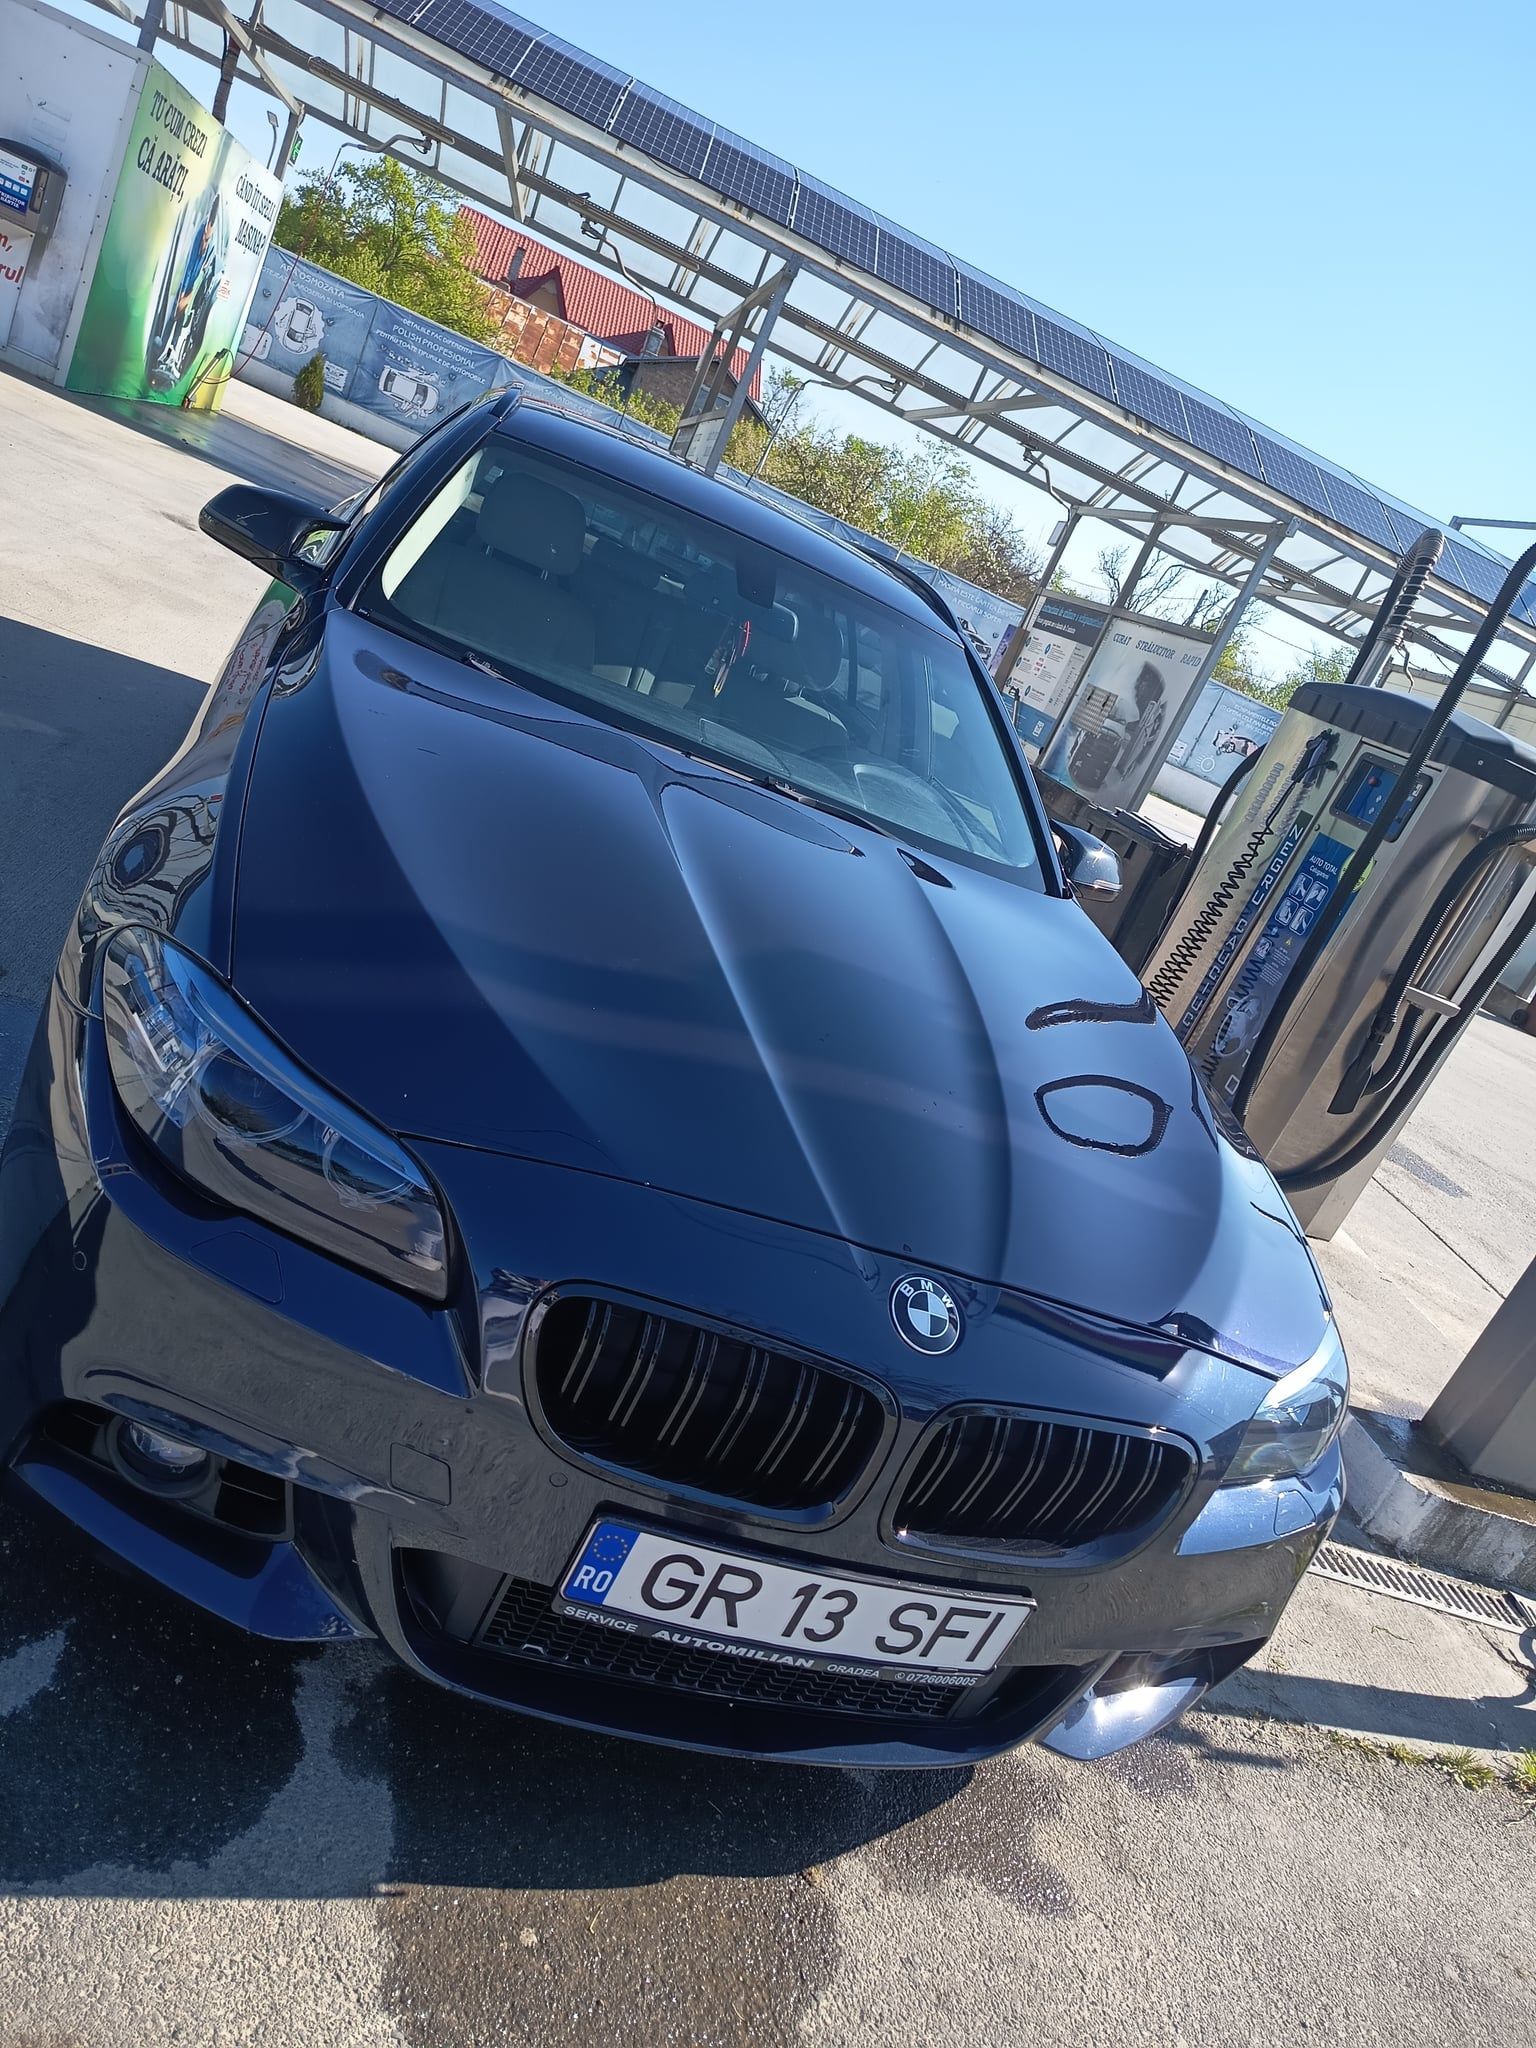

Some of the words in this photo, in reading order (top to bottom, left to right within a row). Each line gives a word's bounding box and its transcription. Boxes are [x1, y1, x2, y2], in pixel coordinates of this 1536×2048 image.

[150, 89, 168, 122] TU
[164, 104, 186, 140] CUM
[183, 120, 208, 158] CREZI
[137, 135, 158, 174] CĂ
[299, 271, 345, 299] OSMOZATA
[375, 329, 399, 344] PENTRU
[399, 340, 418, 353] TOATE
[442, 360, 450, 368] DE
[449, 364, 486, 385] AUTOMOBILE
[392, 324, 422, 343] POLISH
[421, 339, 475, 369] PROFESIONAL
[1180, 653, 1202, 668] RAPID
[1252, 824, 1304, 906] NEGRU
[1309, 855, 1324, 867] AUTO
[1322, 861, 1338, 875] TOTAL
[900, 1280, 954, 1308] BMW
[573, 1565, 613, 1593] RO
[640, 1553, 763, 1629] GR
[781, 1583, 858, 1643] 13
[875, 1602, 1006, 1663] SFI
[563, 1605, 639, 1633] SERVICE
[651, 1630, 815, 1668] AUTOMILIAN
[826, 1663, 880, 1678] ORADEA
[906, 1673, 978, 1686] 0726006005
